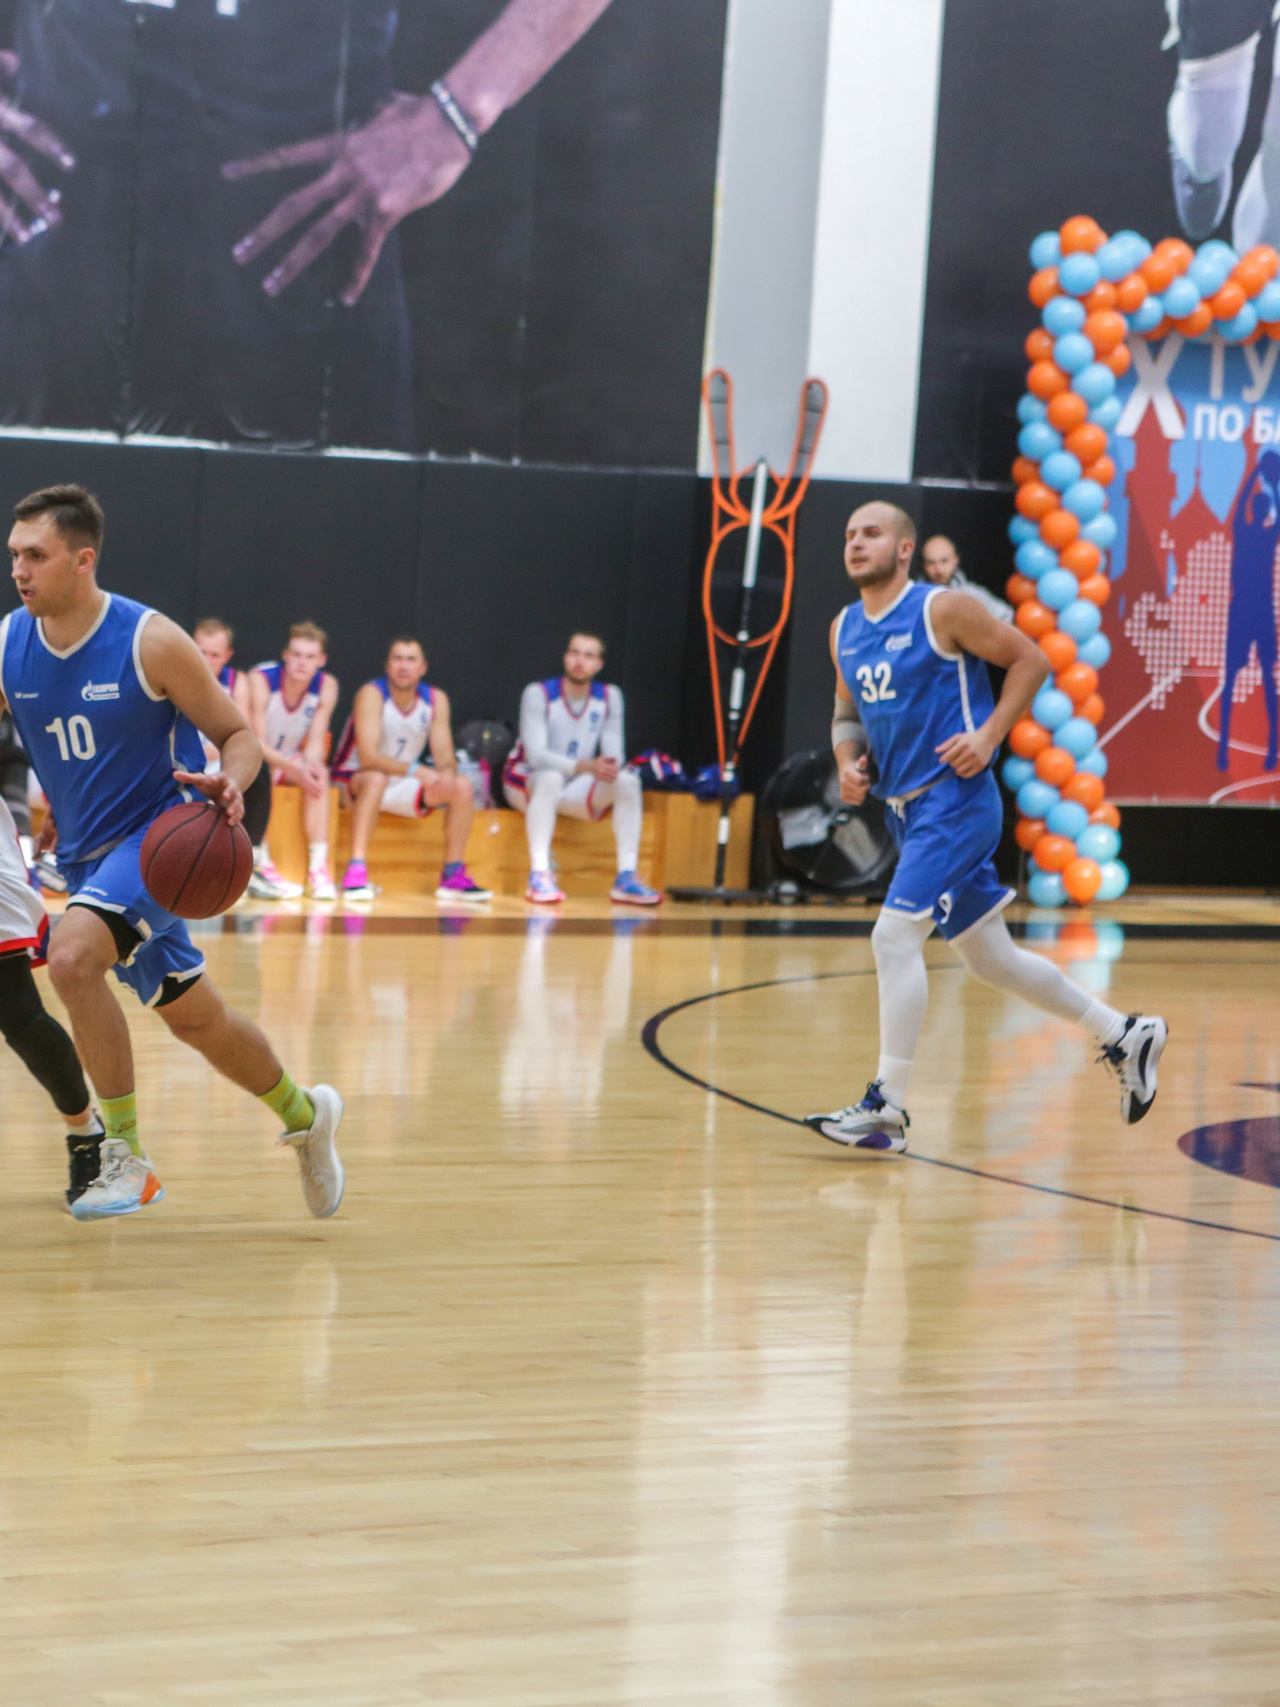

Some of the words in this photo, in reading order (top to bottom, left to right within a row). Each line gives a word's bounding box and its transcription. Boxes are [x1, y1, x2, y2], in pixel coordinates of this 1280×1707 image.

[1193, 403, 1245, 442] ПО
[1252, 406, 1280, 444] Б
[856, 661, 897, 704] 32
[45, 714, 96, 761] 10
